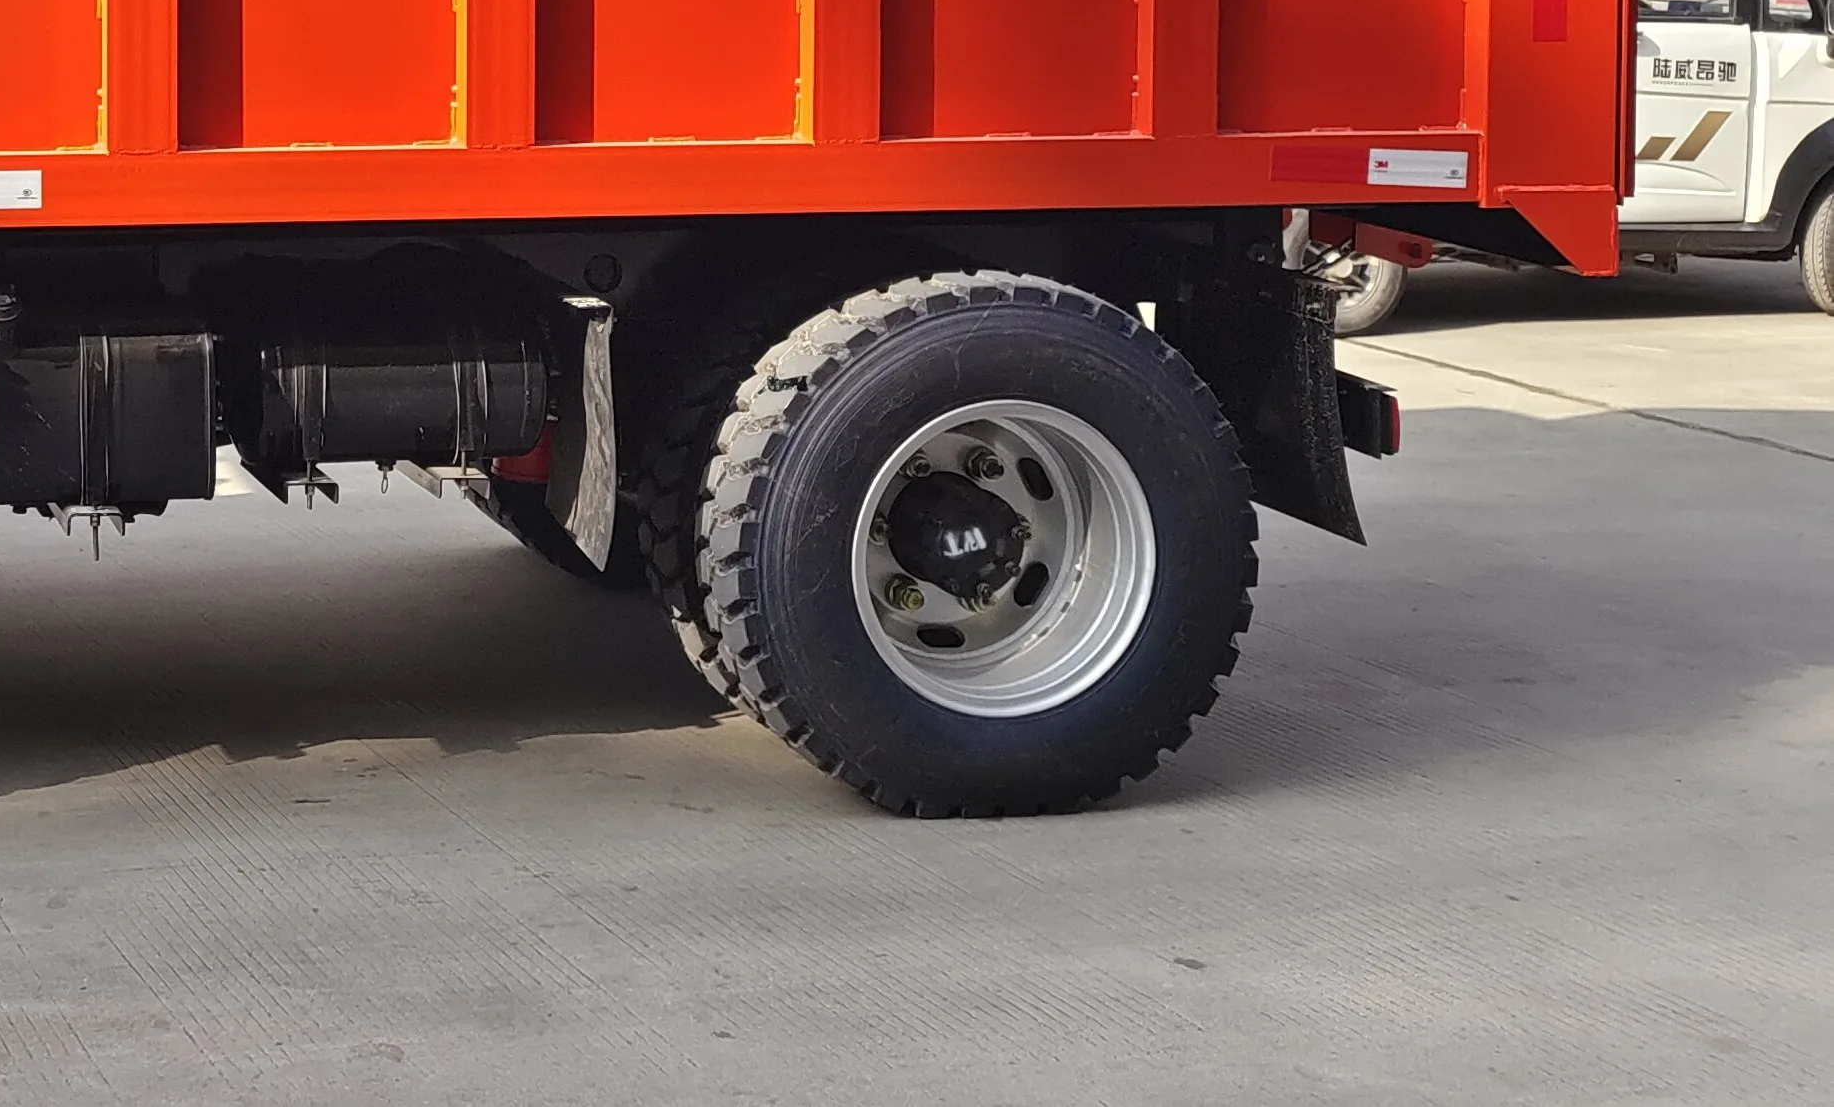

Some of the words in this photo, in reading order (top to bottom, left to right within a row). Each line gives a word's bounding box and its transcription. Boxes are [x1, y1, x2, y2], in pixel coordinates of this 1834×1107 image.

[1652, 58, 1737, 82] 陆威昂驰
[1373, 160, 1389, 169] 3M
